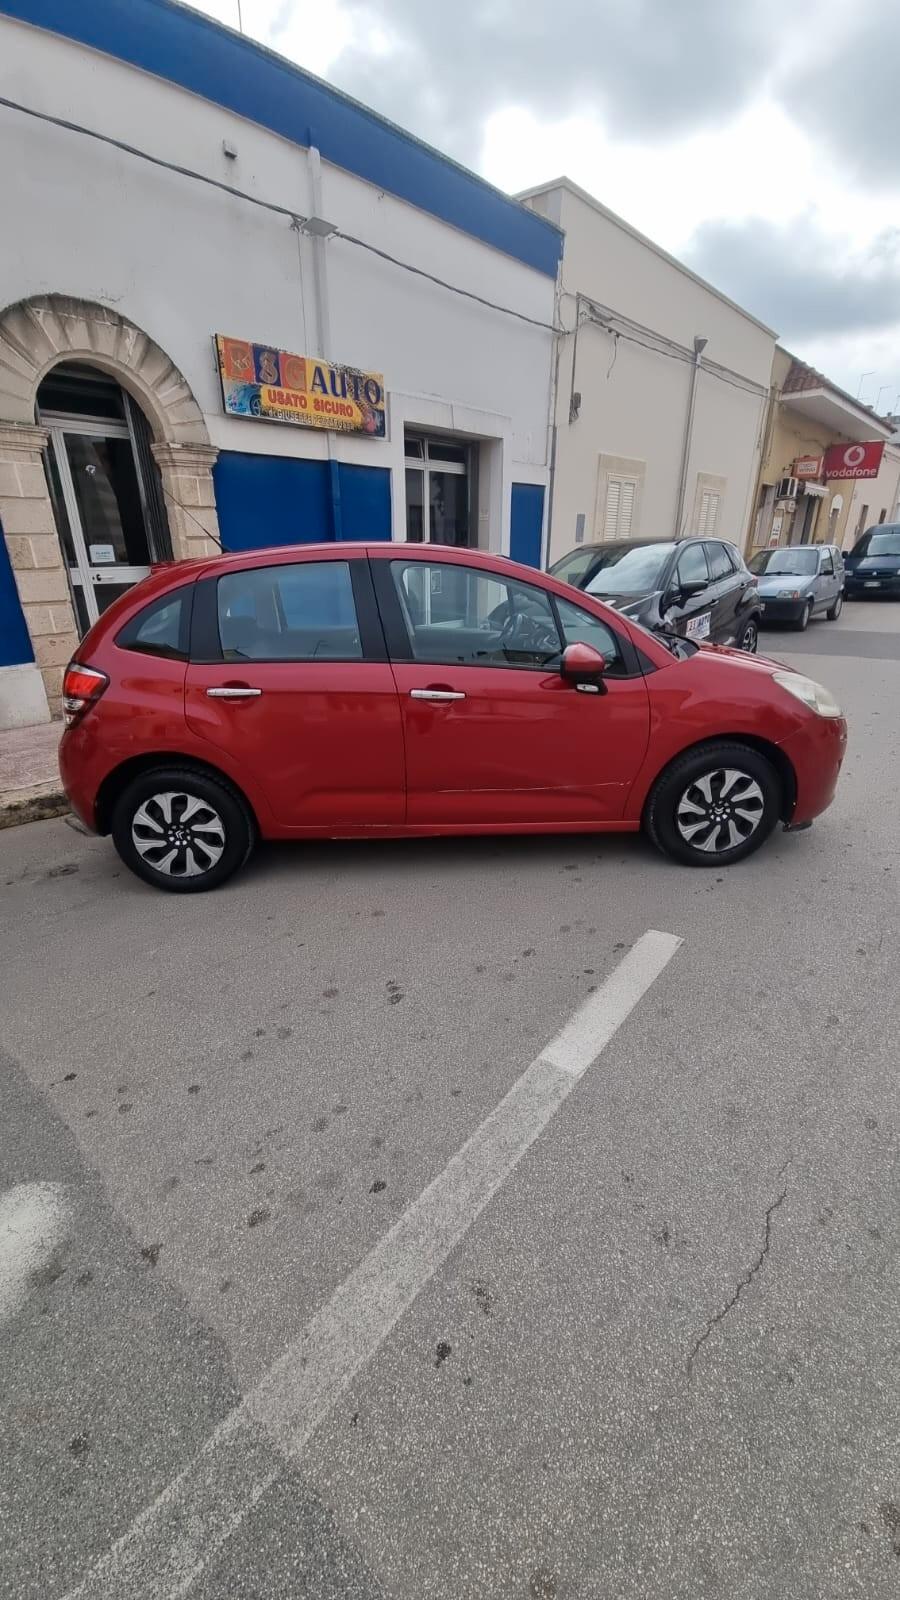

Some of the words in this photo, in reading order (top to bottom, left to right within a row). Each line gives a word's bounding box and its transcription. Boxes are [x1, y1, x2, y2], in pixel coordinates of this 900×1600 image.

[310, 366, 382, 405] AUTO
[267, 389, 308, 409] USATO
[313, 398, 354, 418] SICURO
[826, 467, 877, 478] vodafone
